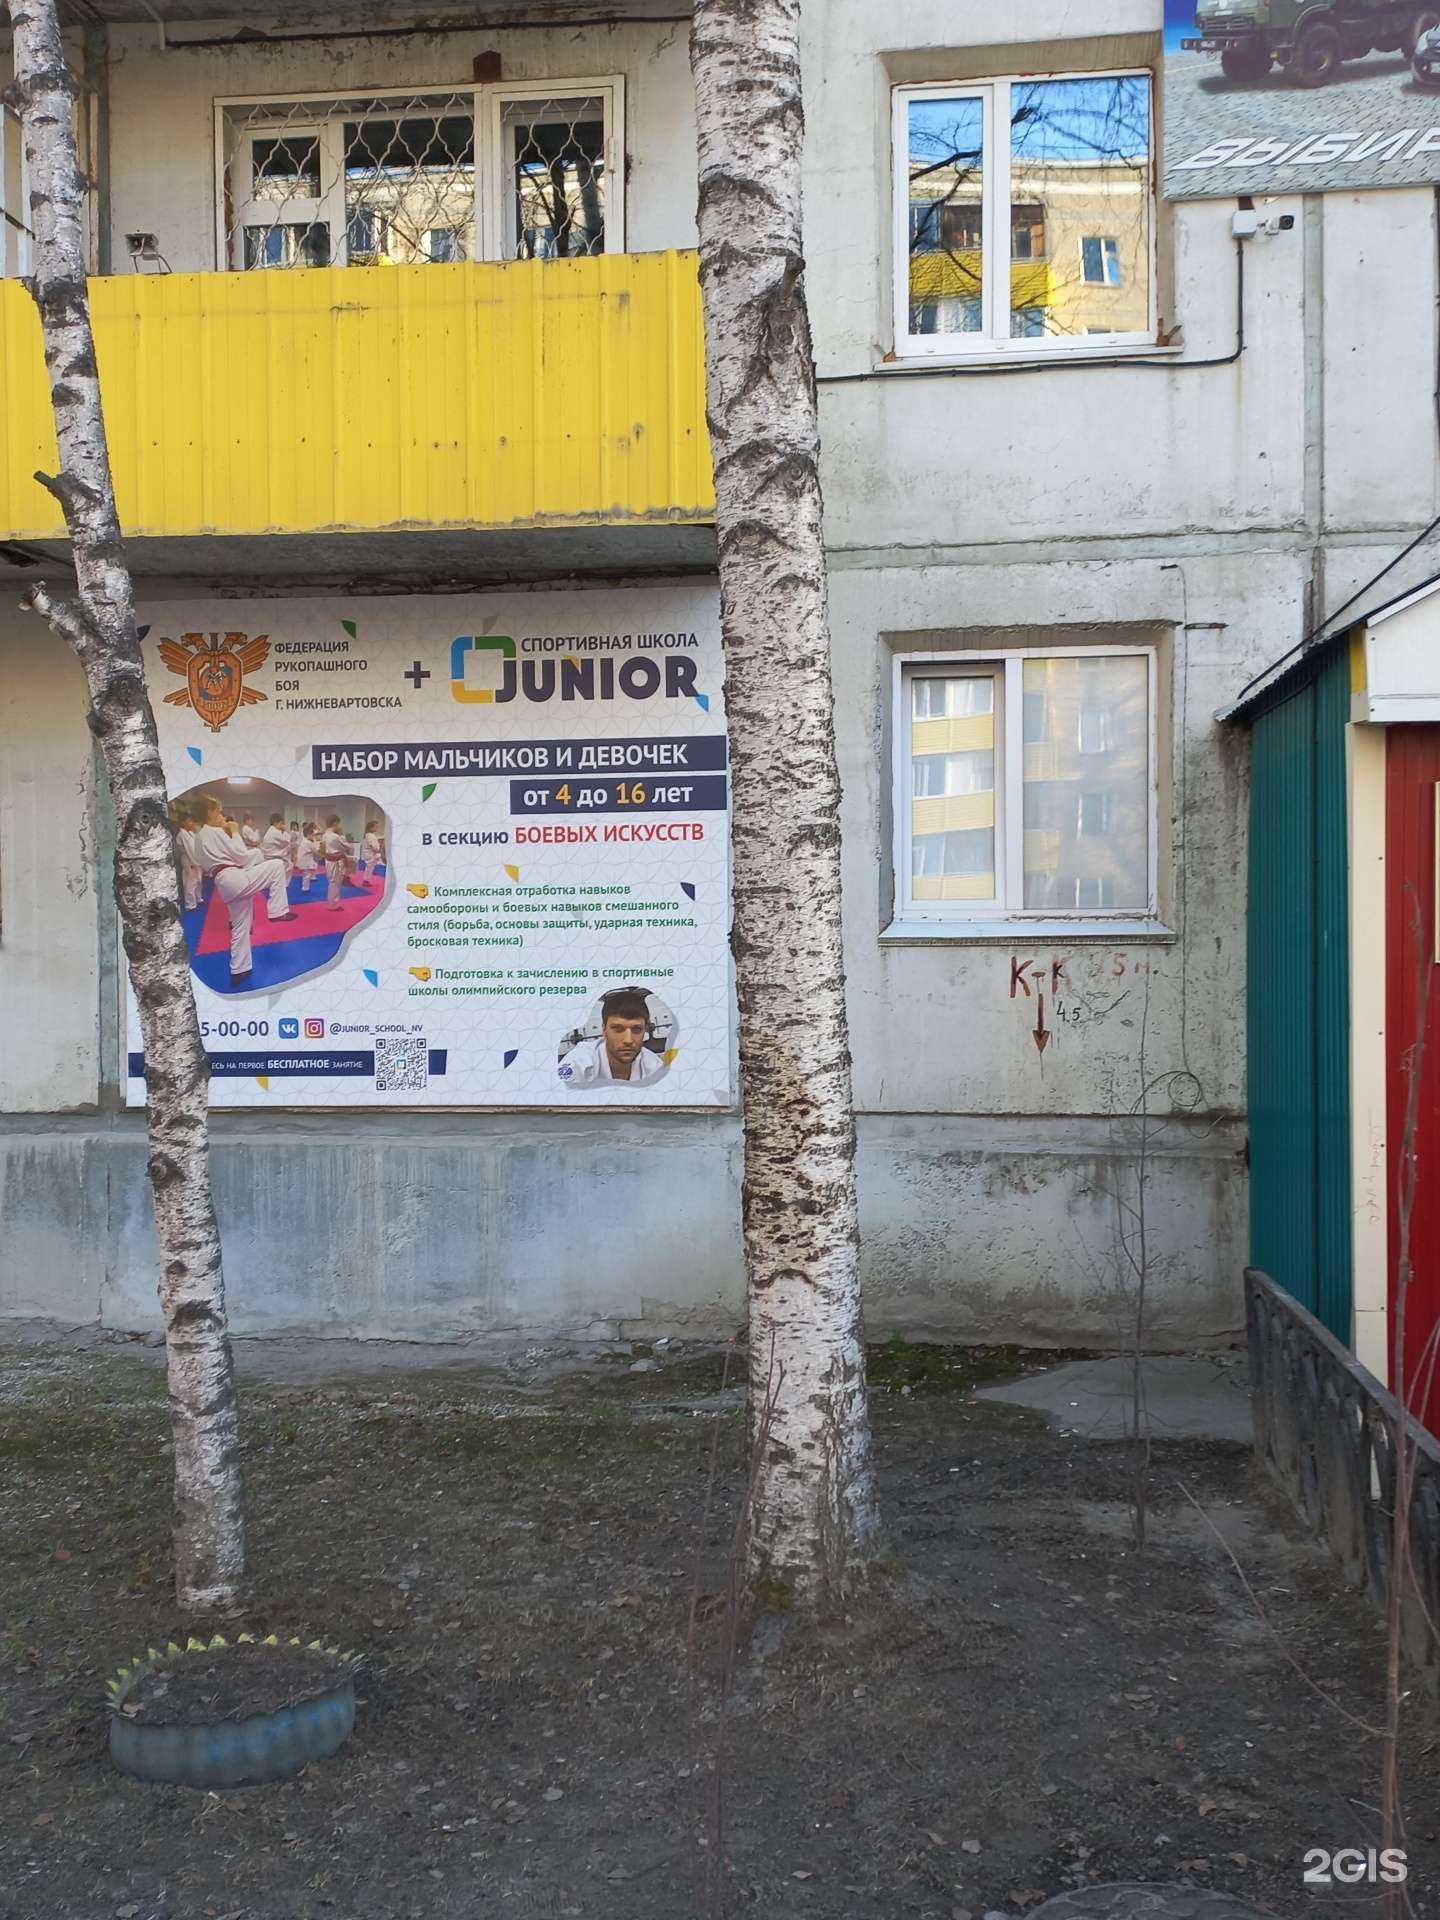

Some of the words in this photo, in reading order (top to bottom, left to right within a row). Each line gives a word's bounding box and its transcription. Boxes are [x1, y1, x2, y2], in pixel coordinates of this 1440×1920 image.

[274, 641, 349, 655] ФЕДЕРАЦИЯ
[521, 635, 632, 652] СПОРТИВНАЯ
[638, 633, 699, 649] ШКОЛА
[274, 659, 368, 673] РУКОПАШНОГО
[275, 679, 299, 691] БОЯ
[495, 655, 699, 703] JUNIOR
[275, 700, 284, 710] Г.
[287, 697, 402, 710] НИЖНЕВАРТОВСКА
[321, 750, 398, 772] НАБОР
[404, 747, 548, 770] МАЛЬЧИКОВ
[556, 747, 572, 767] И
[578, 744, 688, 769] ДЕВОЧЕК
[523, 789, 549, 806] от
[555, 783, 571, 805] 4
[576, 788, 608, 807] до
[616, 782, 646, 804] 16
[651, 786, 693, 803] лет
[422, 833, 432, 845] в
[438, 831, 508, 847] секцию
[515, 825, 597, 844] БОЕВЫХ
[604, 823, 704, 842] ИСКУССТВ
[434, 886, 512, 897] Комплексная
[515, 885, 576, 898] отработка
[579, 885, 631, 895] навыков
[407, 903, 488, 915] самообороны
[503, 902, 547, 912] боевых
[551, 903, 602, 912] навыков
[605, 902, 679, 911] смешанного
[407, 921, 439, 930] стиля
[443, 919, 493, 932] (борьба,
[495, 920, 539, 929] основы
[543, 920, 592, 930] защиты,
[595, 919, 643, 930] ударная
[646, 918, 698, 928] техника,
[407, 936, 469, 949] бросковая
[472, 935, 524, 947] техника)
[435, 969, 503, 980] Подготовка
[507, 970, 513, 978] к
[517, 969, 588, 979] зачислению
[592, 969, 599, 977] в
[602, 968, 674, 980] спортивные
[408, 987, 448, 996] школы
[451, 984, 536, 995] олимпийского
[539, 985, 587, 996] резерва
[329, 1023, 423, 1035] @JUNIOR_SCHOOL_NV
[267, 1059, 330, 1069] БЕСПЛАТНОЕ
[332, 1061, 363, 1069] ЗАНЯТИЕ
